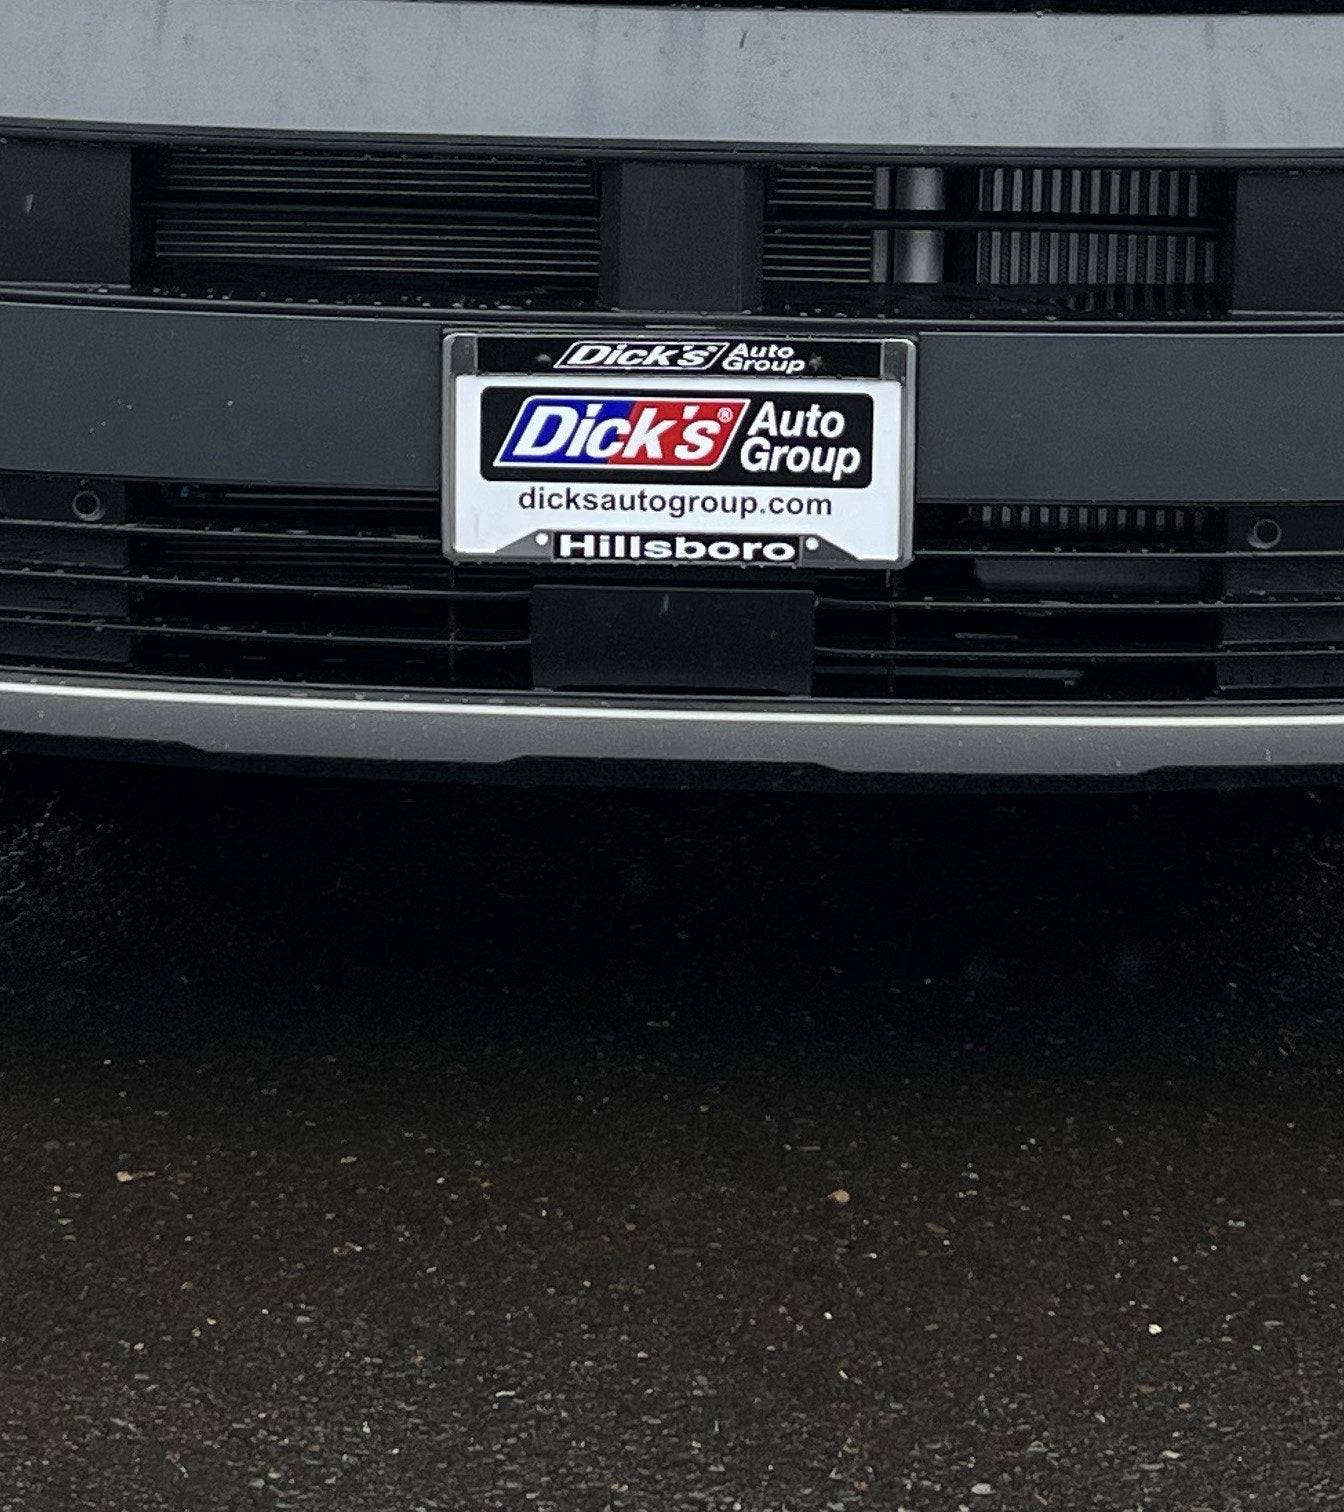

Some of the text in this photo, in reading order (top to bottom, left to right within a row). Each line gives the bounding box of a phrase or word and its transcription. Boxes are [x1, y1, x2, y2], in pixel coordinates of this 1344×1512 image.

[567, 343, 707, 366] Dick's
[729, 343, 794, 358] Auto
[722, 357, 806, 374] Group
[512, 403, 721, 460] Dick's
[748, 401, 845, 437] Auto
[740, 437, 861, 481] Group
[518, 487, 832, 519] dicksautogroup.com
[559, 534, 796, 561] Hillsboro
